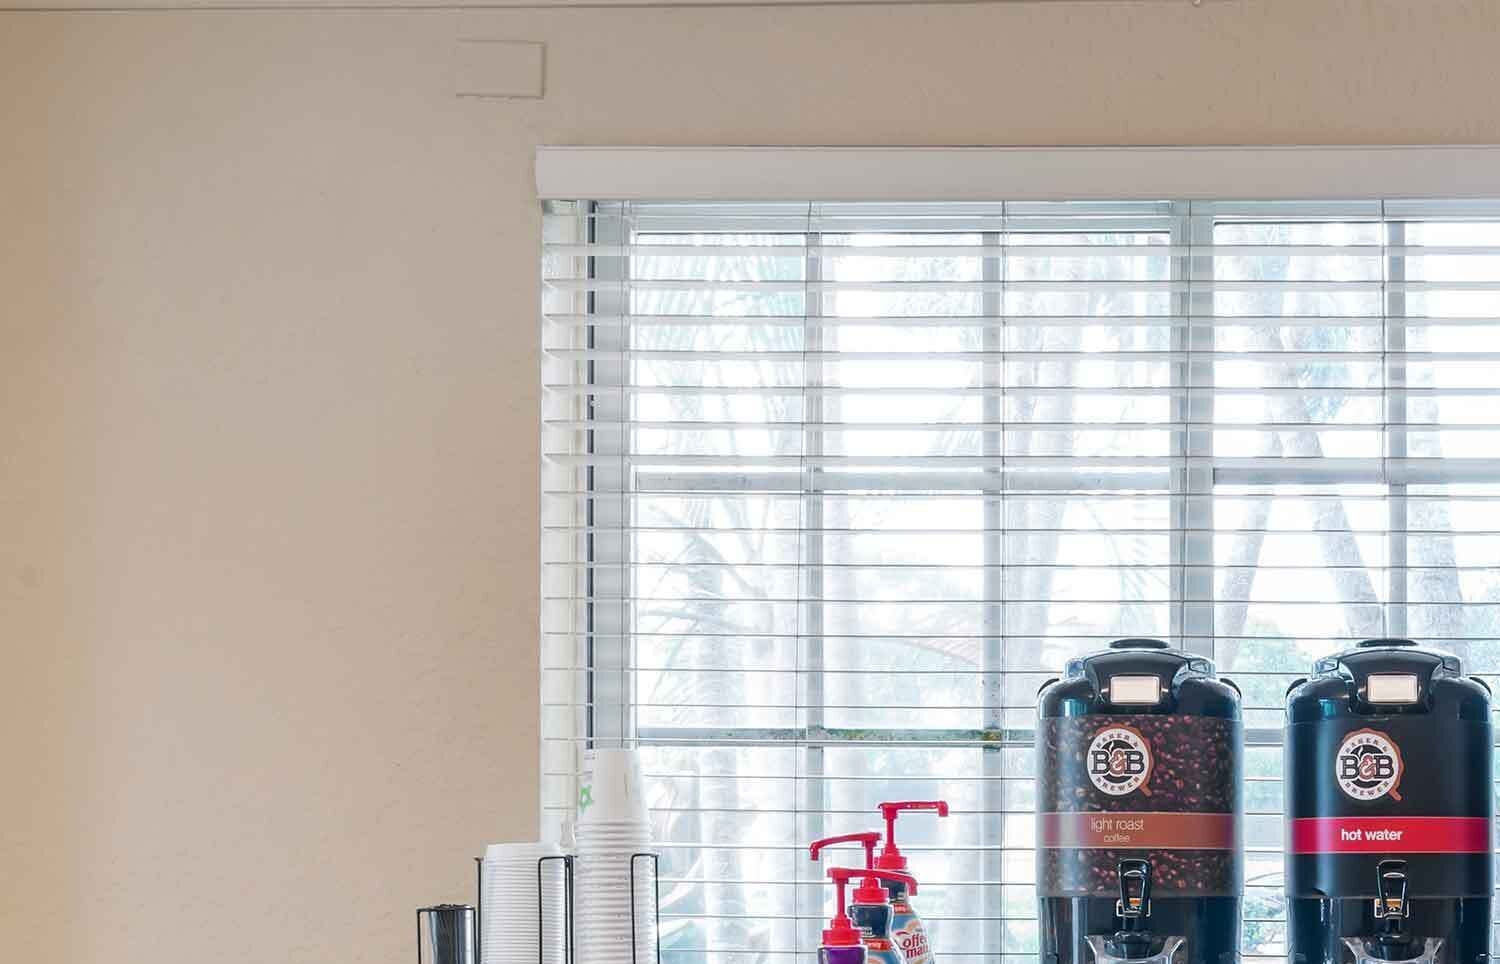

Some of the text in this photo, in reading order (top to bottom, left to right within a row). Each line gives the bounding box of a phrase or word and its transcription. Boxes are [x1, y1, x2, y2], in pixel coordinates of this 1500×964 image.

[1091, 749, 1145, 776] B&B
[1340, 754, 1395, 781] B&B
[1090, 817, 1144, 832] light roast
[1103, 834, 1130, 843] coffee
[1341, 829, 1402, 841] hot water
